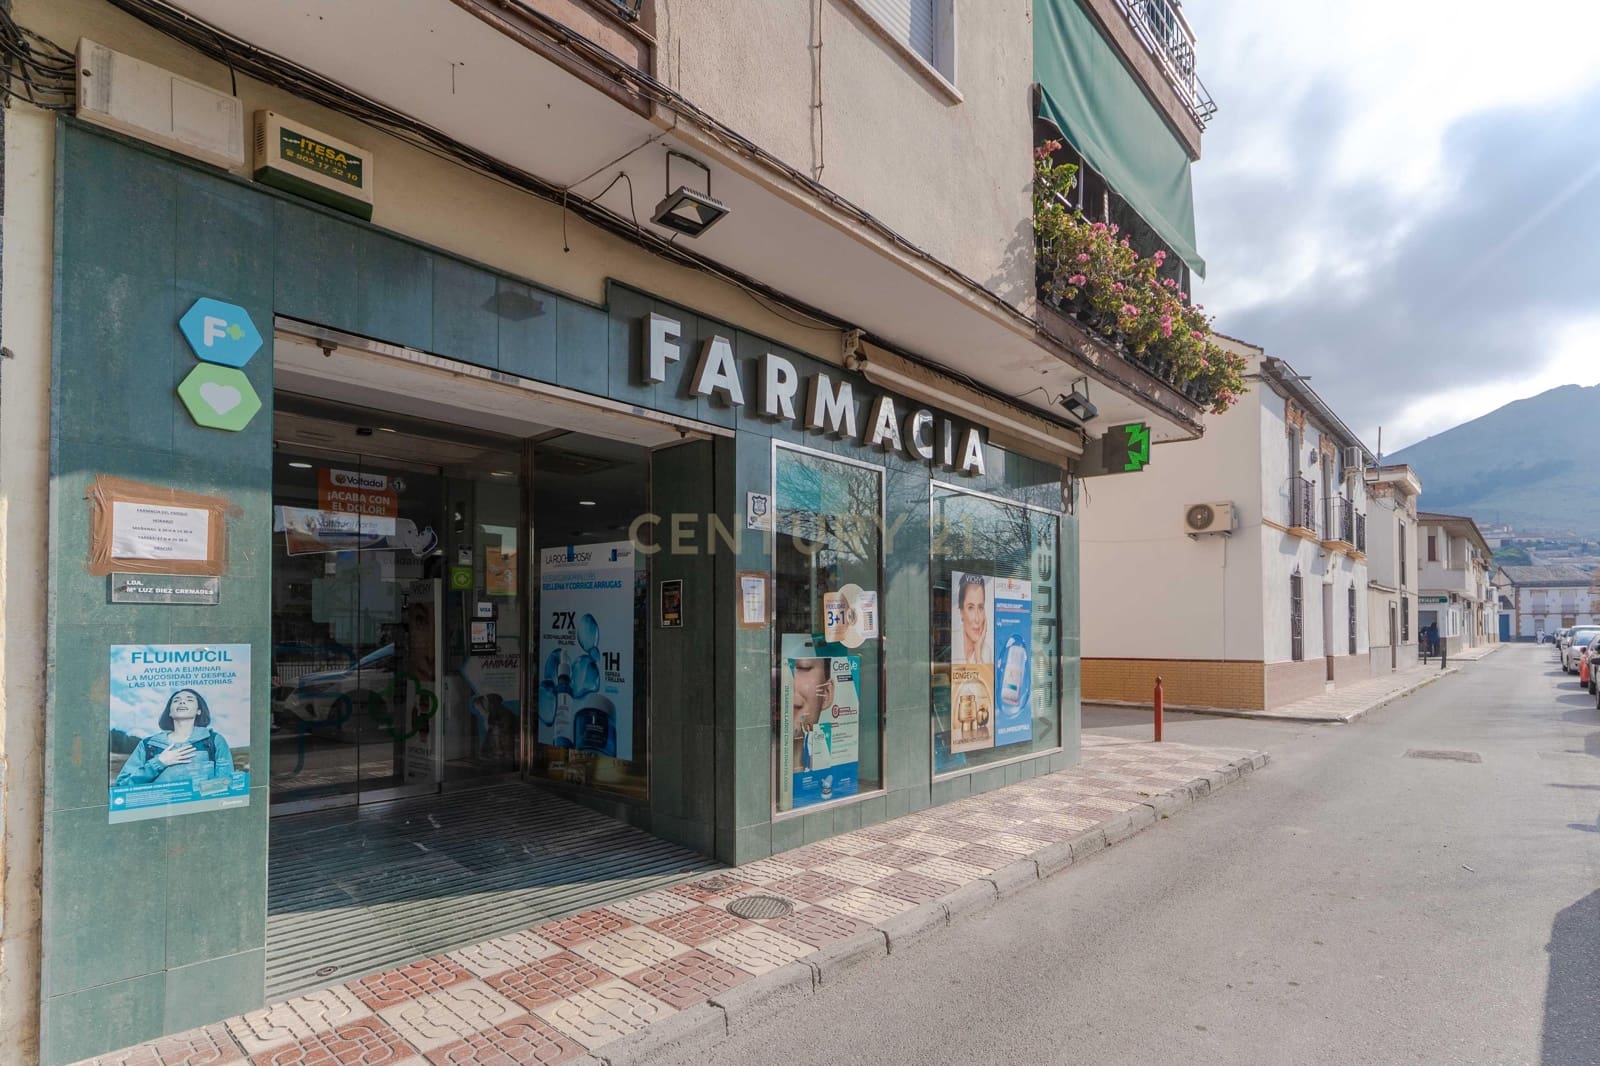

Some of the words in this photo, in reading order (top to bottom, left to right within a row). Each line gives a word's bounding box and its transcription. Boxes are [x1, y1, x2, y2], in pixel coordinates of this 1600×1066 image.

[300, 138, 348, 165] ITESA
[642, 311, 985, 477] FARMACIA
[347, 475, 384, 488] Voltadol
[327, 491, 367, 503] ¡ACABA
[368, 495, 390, 505] CON
[332, 502, 345, 511] EL
[346, 503, 386, 516] DOLOR!
[593, 580, 622, 589] ARRUGAS
[965, 574, 984, 584] VICHY
[551, 611, 576, 630] 27X
[827, 610, 847, 627] 3+1
[131, 650, 233, 664] FLUIMUCIL
[481, 658, 519, 669] ANIMAL
[602, 651, 620, 671] 1H
[182, 665, 221, 673] ELIMINAR
[832, 660, 858, 672] CeraVe
[139, 673, 192, 681] MUCOSIDAD
[147, 680, 167, 688] VÍAS
[168, 679, 233, 687] RESPIRATORIAS
